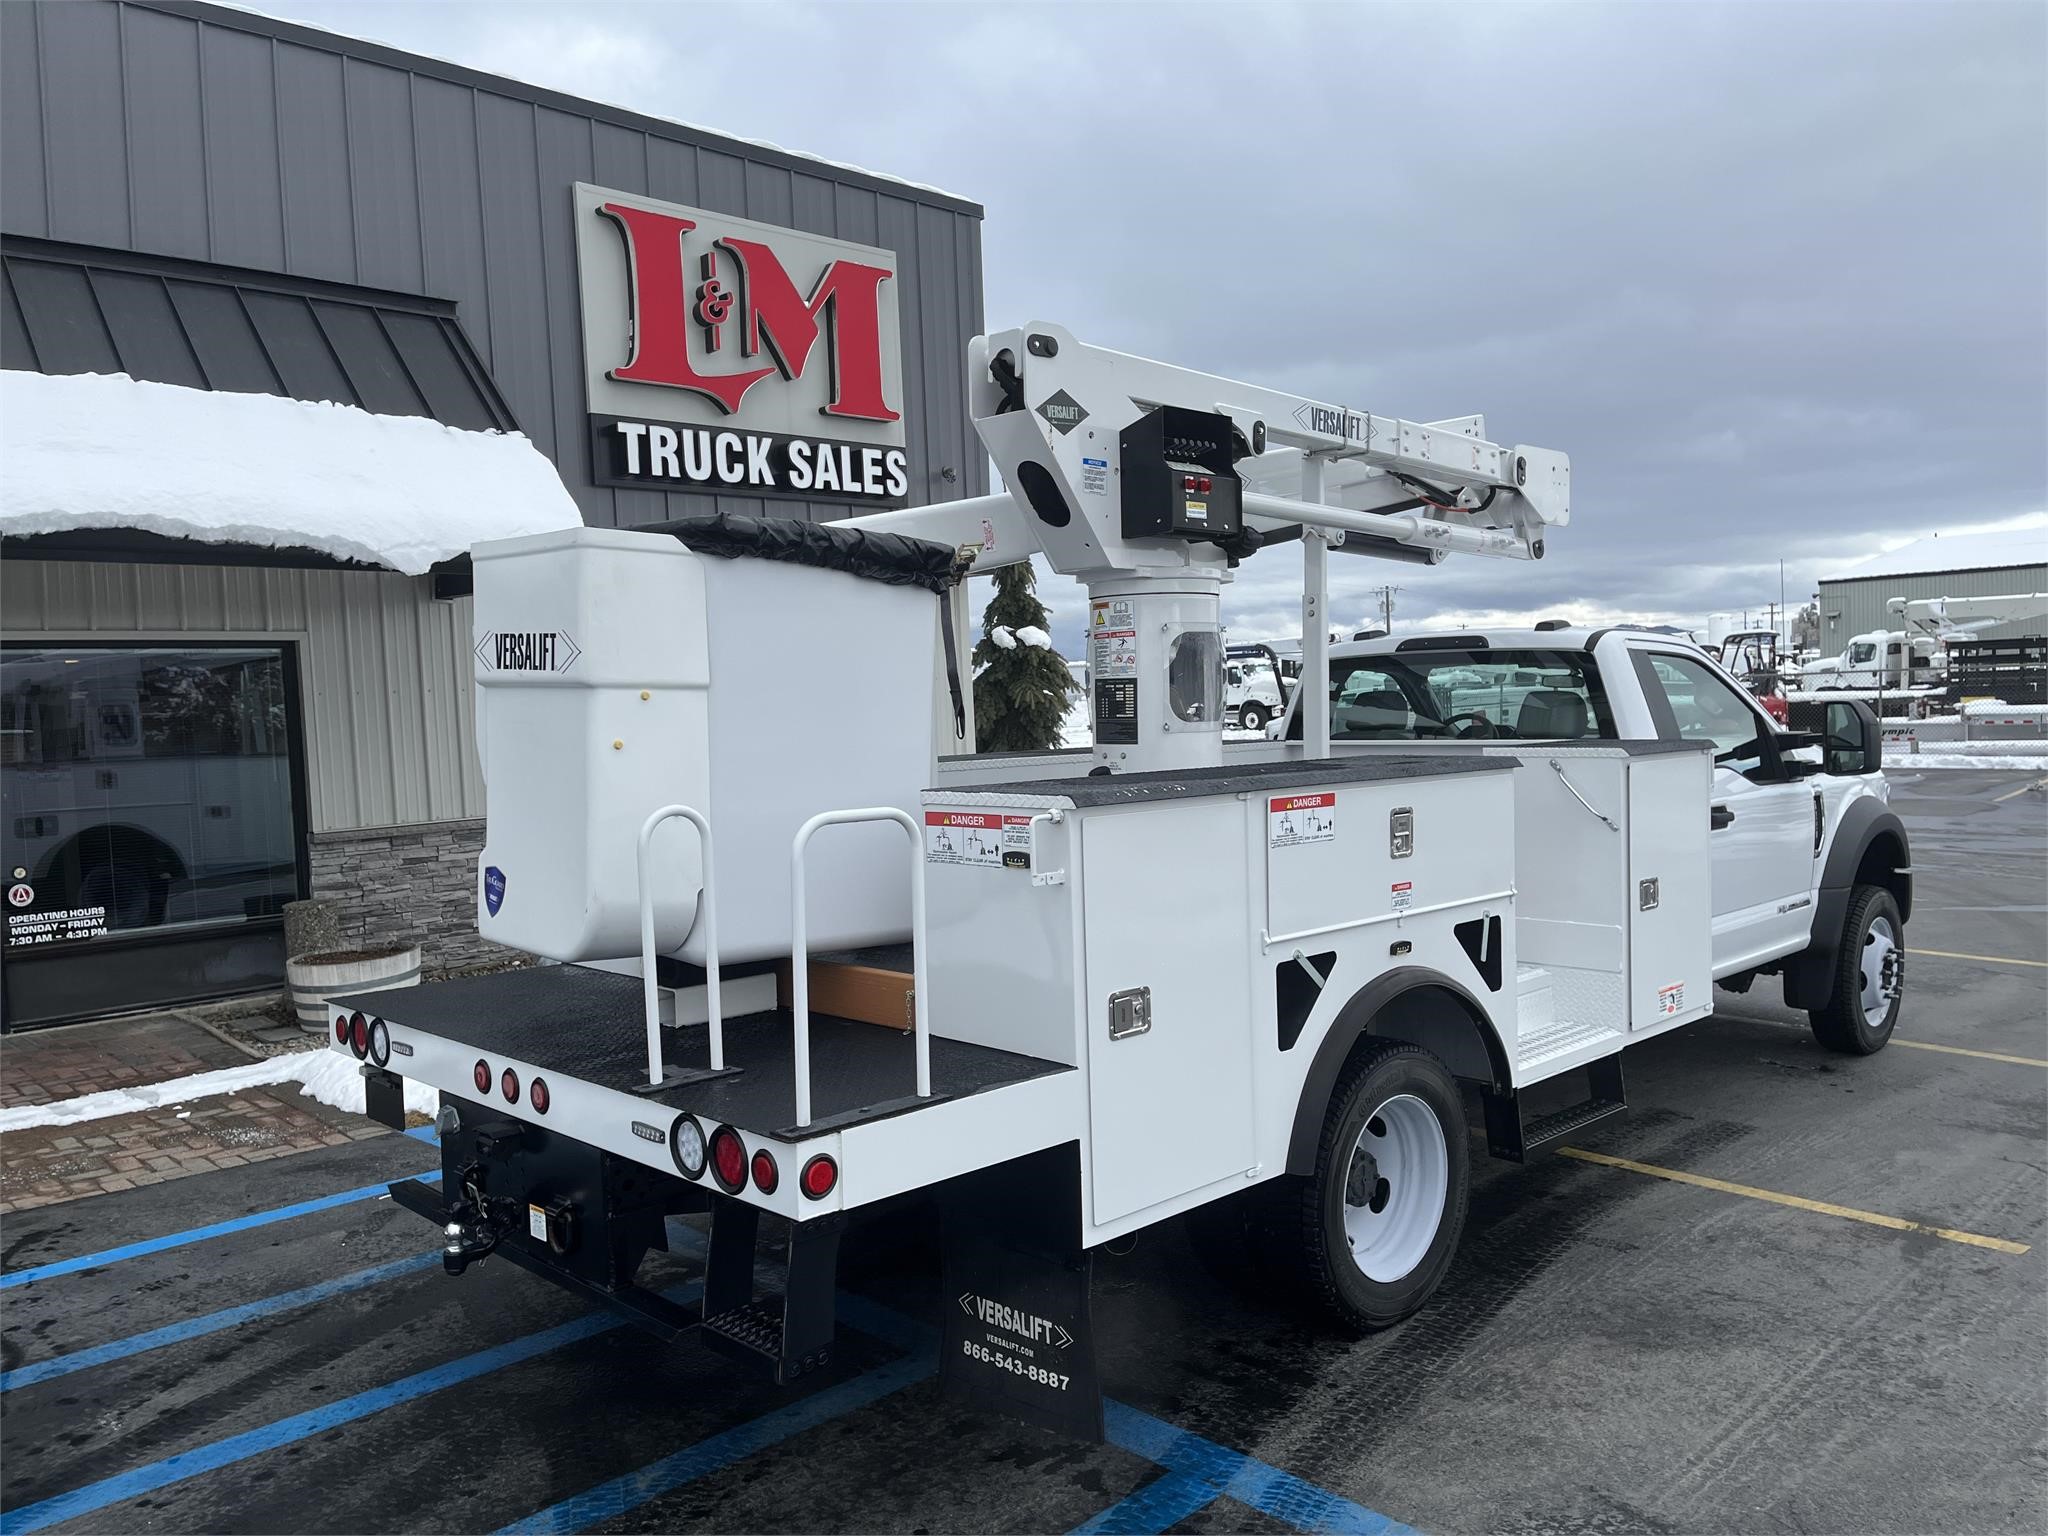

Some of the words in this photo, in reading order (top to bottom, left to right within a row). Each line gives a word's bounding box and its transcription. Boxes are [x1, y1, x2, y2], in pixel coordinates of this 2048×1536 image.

[600, 202, 901, 421] L&M
[1046, 404, 1079, 420] VERSALIFT
[1311, 406, 1362, 441] VERSALIFT
[616, 421, 776, 486] TRUCK
[788, 439, 908, 497] SALES
[495, 632, 557, 672] VERSALIFT
[1881, 727, 1915, 737] ympic
[1293, 797, 1322, 807] DANGER
[951, 814, 985, 827] DANGER
[9, 911, 68, 924] OPERATING
[69, 907, 105, 918] HOURS
[11, 923, 59, 935] MONDAY
[68, 918, 105, 929] FRIDAY
[9, 937, 33, 946] 7:30
[35, 934, 52, 943] AM
[66, 930, 89, 939] 4:30
[91, 927, 108, 936] PM
[976, 1296, 1053, 1345] VERSALIFT
[986, 1333, 1034, 1358] VERSALIFT.COM
[963, 1340, 1070, 1391] 866-543-8887
